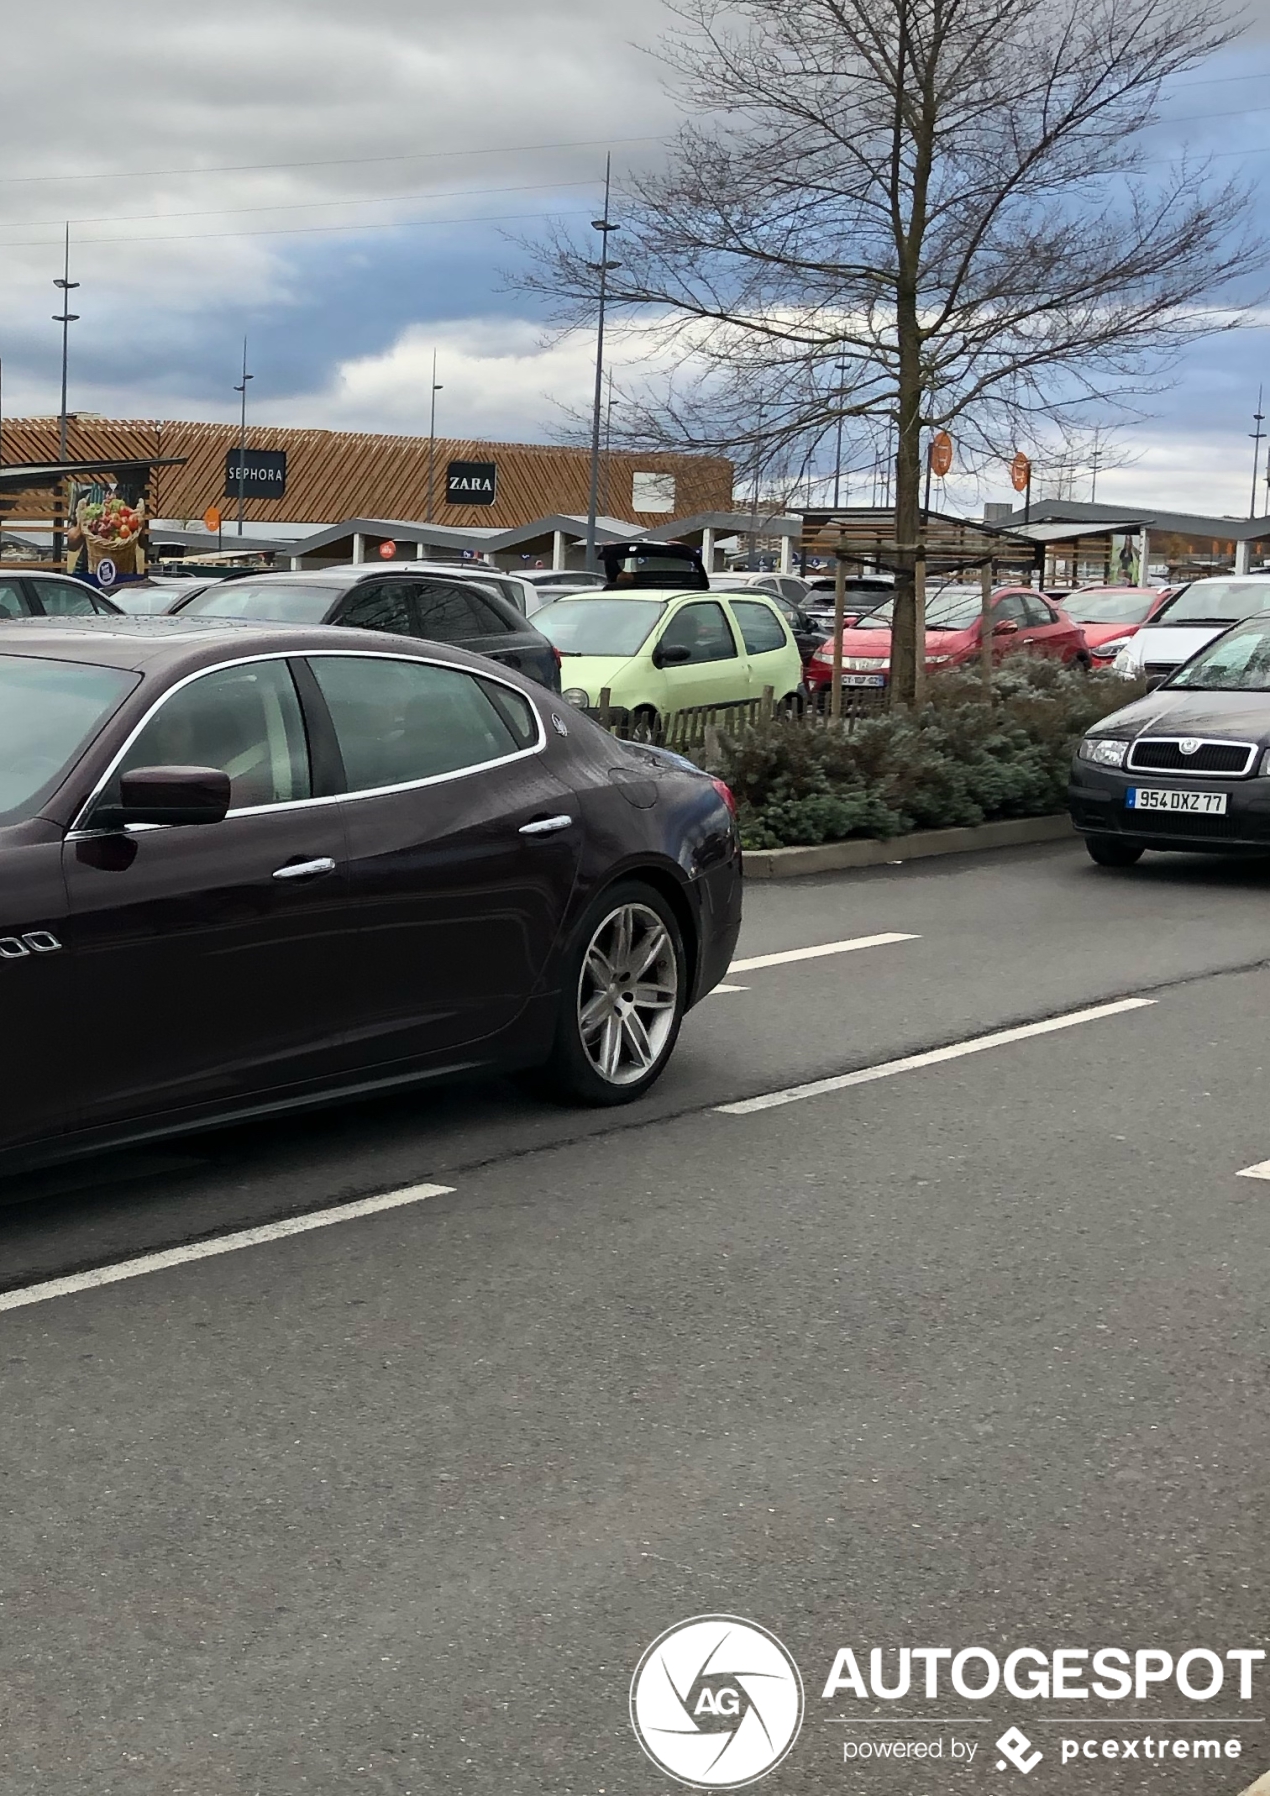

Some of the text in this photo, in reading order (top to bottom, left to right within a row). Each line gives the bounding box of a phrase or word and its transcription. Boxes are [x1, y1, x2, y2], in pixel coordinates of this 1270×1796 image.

[228, 466, 282, 482] SEPHORA
[449, 476, 493, 492] ZARA
[1140, 791, 1222, 812] 954 DXZ 77
